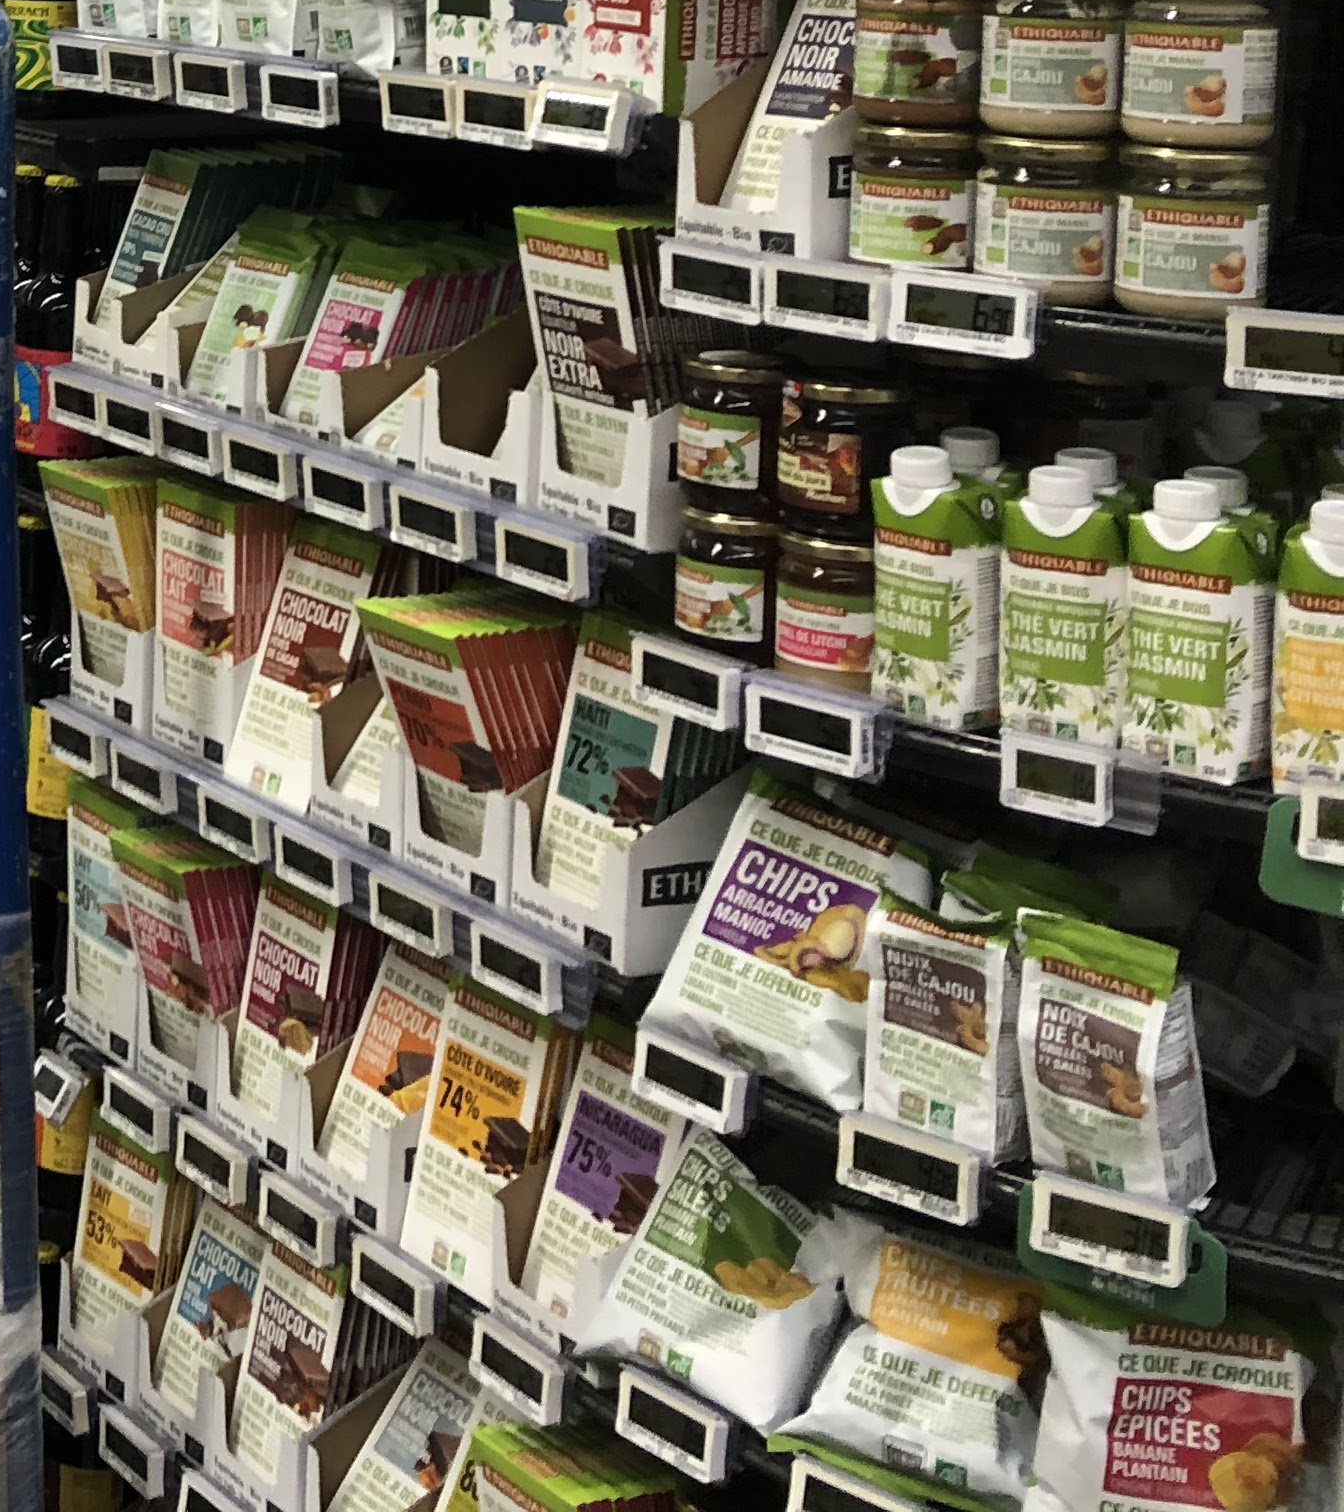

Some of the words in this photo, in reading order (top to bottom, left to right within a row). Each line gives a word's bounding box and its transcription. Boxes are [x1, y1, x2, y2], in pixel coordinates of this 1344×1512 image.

[1013, 27, 1104, 41] ETHIQUABLE
[786, 45, 837, 69] NOIR
[779, 72, 843, 90] AMANDE
[1013, 69, 1064, 86] CAJOU
[1146, 210, 1242, 226] ETHIQUABLE
[528, 238, 607, 267] ETHIQUABLE
[1011, 240, 1062, 256] CAJOU
[1145, 252, 1198, 272] CAJOU
[328, 301, 374, 323] CHOCOLAT
[544, 329, 585, 361] NOIR
[549, 358, 603, 390] EXTRA
[163, 552, 224, 588] CHOCOLAT
[163, 577, 187, 602] LAIT
[280, 591, 349, 632] CHOCOLAT
[1011, 607, 1043, 634] THÉ
[1048, 611, 1100, 641] VERT
[273, 615, 307, 644] NOIR
[1131, 625, 1163, 652] THÉ
[1170, 632, 1222, 660] VERT
[1009, 632, 1087, 662] JASMIN
[1129, 651, 1207, 682] JASMIN
[565, 735, 610, 776] 72%
[750, 819, 767, 838] CE
[770, 829, 801, 853] QUE
[803, 843, 822, 863] JE
[825, 850, 891, 887] CROQUE
[736, 850, 839, 914] CHIPS
[713, 903, 776, 940] MANIOC
[722, 885, 813, 932] ARRACACHA
[131, 905, 190, 956] CHOCOLAT
[258, 935, 320, 988] CHOCOLAT
[693, 942, 709, 959] CE
[712, 949, 733, 970] QUE
[736, 960, 751, 977] JE
[753, 966, 824, 1008] DÉFENDS
[886, 948, 932, 973] NOIX
[254, 962, 283, 994] NOIR
[917, 970, 975, 1004] CAJOU
[1041, 1004, 1088, 1030] NOIX
[369, 1021, 401, 1049] NOIR
[1041, 1023, 1066, 1046] DE
[1071, 1031, 1126, 1066] CAJOU
[447, 1042, 473, 1070] CÔTE
[438, 1077, 480, 1121] 74%
[580, 1094, 663, 1152] NICARAGUA
[567, 1130, 612, 1178] 75%
[91, 1176, 113, 1208] LAIT
[85, 1208, 118, 1250] 53%
[190, 1257, 218, 1288] LAIT
[196, 1234, 259, 1292] CHOCOLAT
[257, 1315, 288, 1351] NOIR
[262, 1290, 328, 1354] CHOCOLAT
[1133, 1323, 1284, 1359] ETHIQUABLE
[1118, 1354, 1140, 1372] CE
[1142, 1356, 1180, 1375] QUE
[1183, 1359, 1208, 1379] JE
[1211, 1362, 1295, 1390] CROQUE
[1121, 1385, 1193, 1414] CHIPS
[1113, 1413, 1222, 1452] ÉPICÉES
[1112, 1443, 1178, 1465] BANANE
[1111, 1460, 1189, 1485] PLANTAIN
